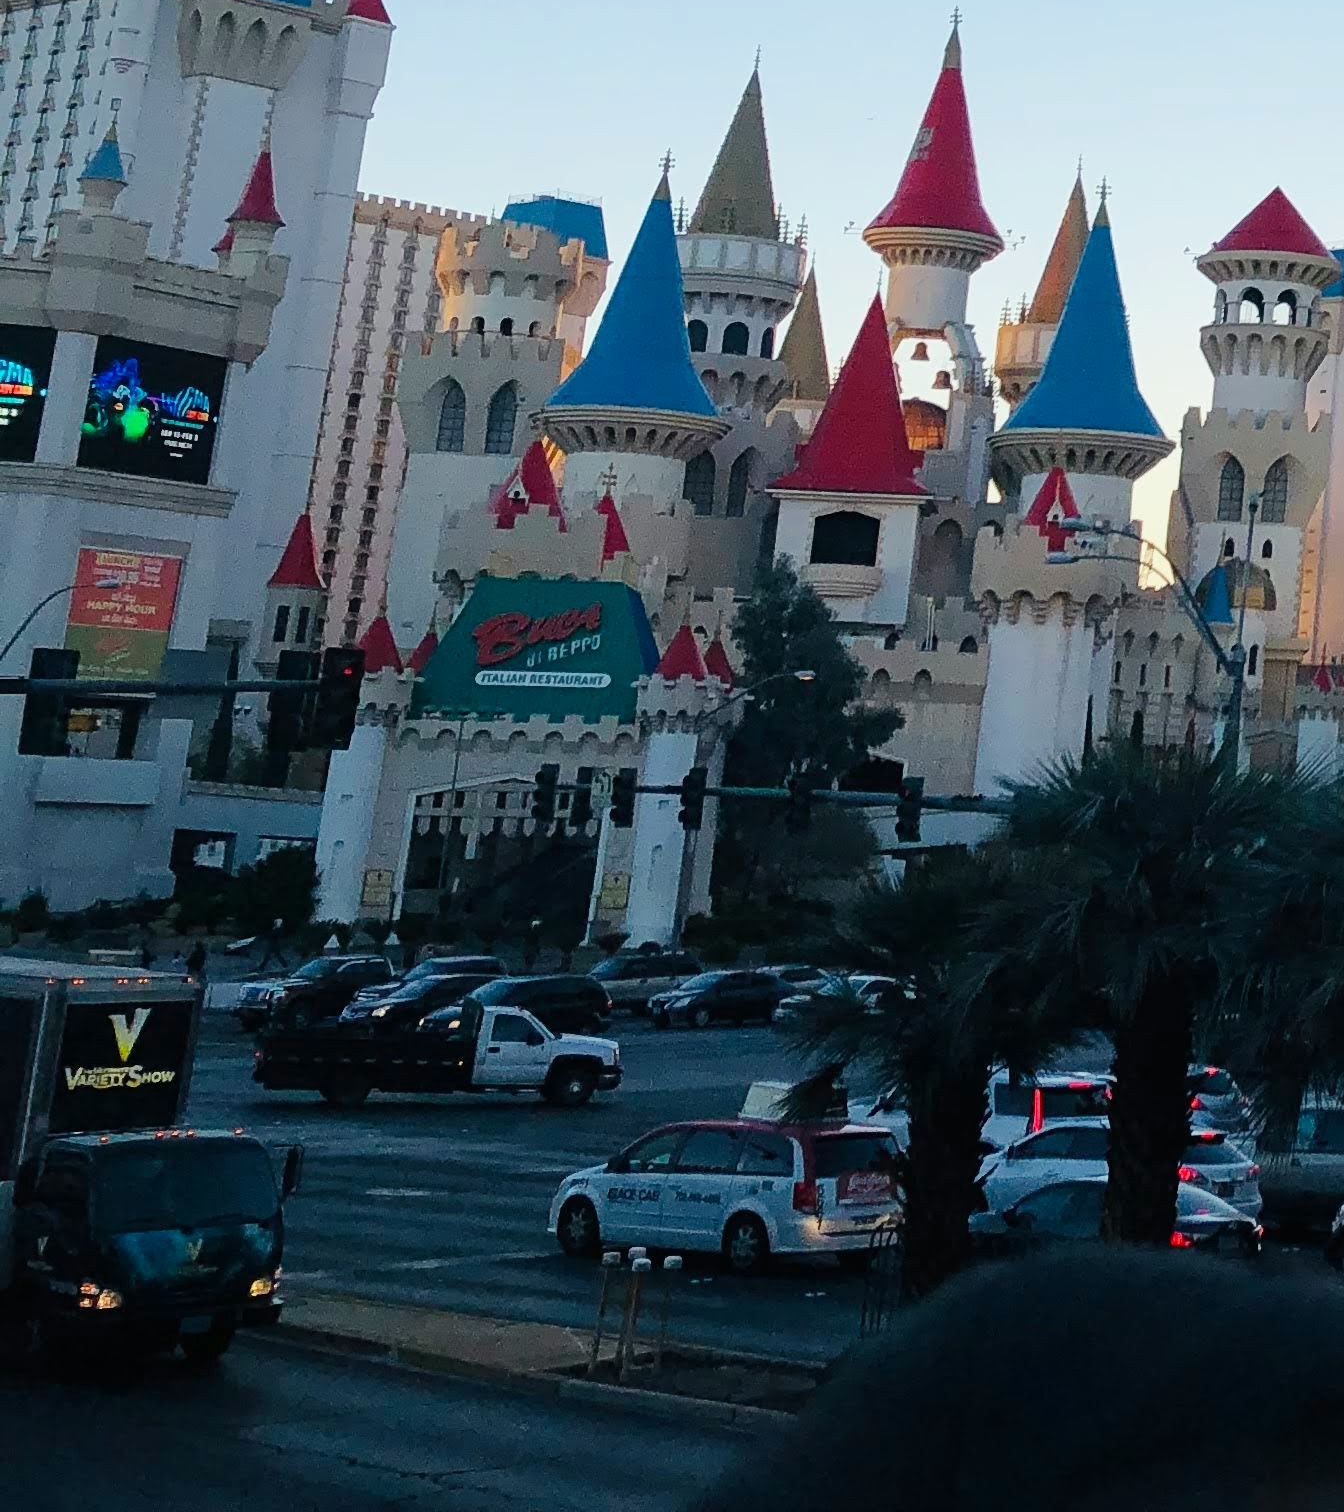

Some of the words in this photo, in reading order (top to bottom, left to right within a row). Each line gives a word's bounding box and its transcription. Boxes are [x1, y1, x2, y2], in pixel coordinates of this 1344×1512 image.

[86, 600, 122, 612] HAPPY
[125, 604, 156, 615] HOUR
[547, 634, 602, 662] BEPPO
[480, 672, 527, 684] ITALIAN
[529, 673, 604, 686] RESTAURANT
[108, 1008, 152, 1062] V
[126, 1065, 175, 1088] SHOW
